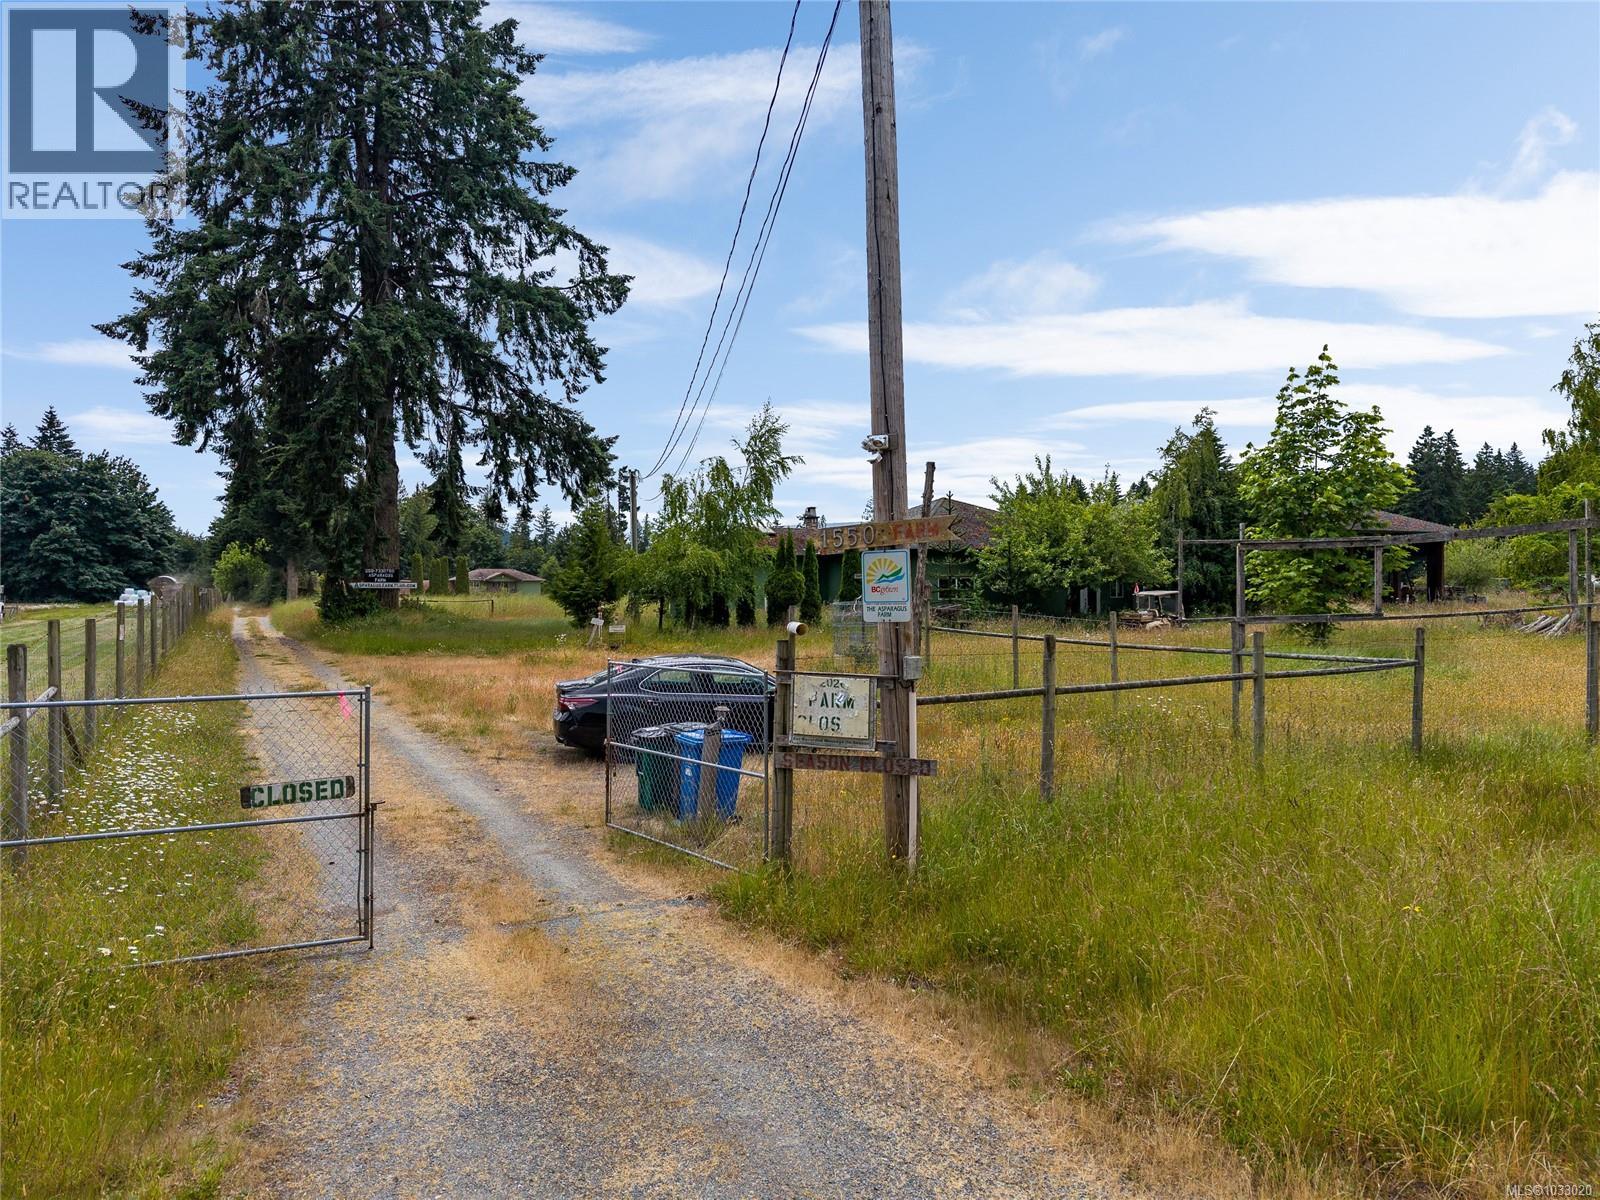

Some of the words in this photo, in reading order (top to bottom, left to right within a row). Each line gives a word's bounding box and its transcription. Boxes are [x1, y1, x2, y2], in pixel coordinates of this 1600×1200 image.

[820, 525, 876, 549] 1550
[892, 521, 940, 540] FARM
[783, 753, 850, 771] SEASON
[859, 757, 931, 776] CLOSED
[250, 778, 345, 808] CLOSED
